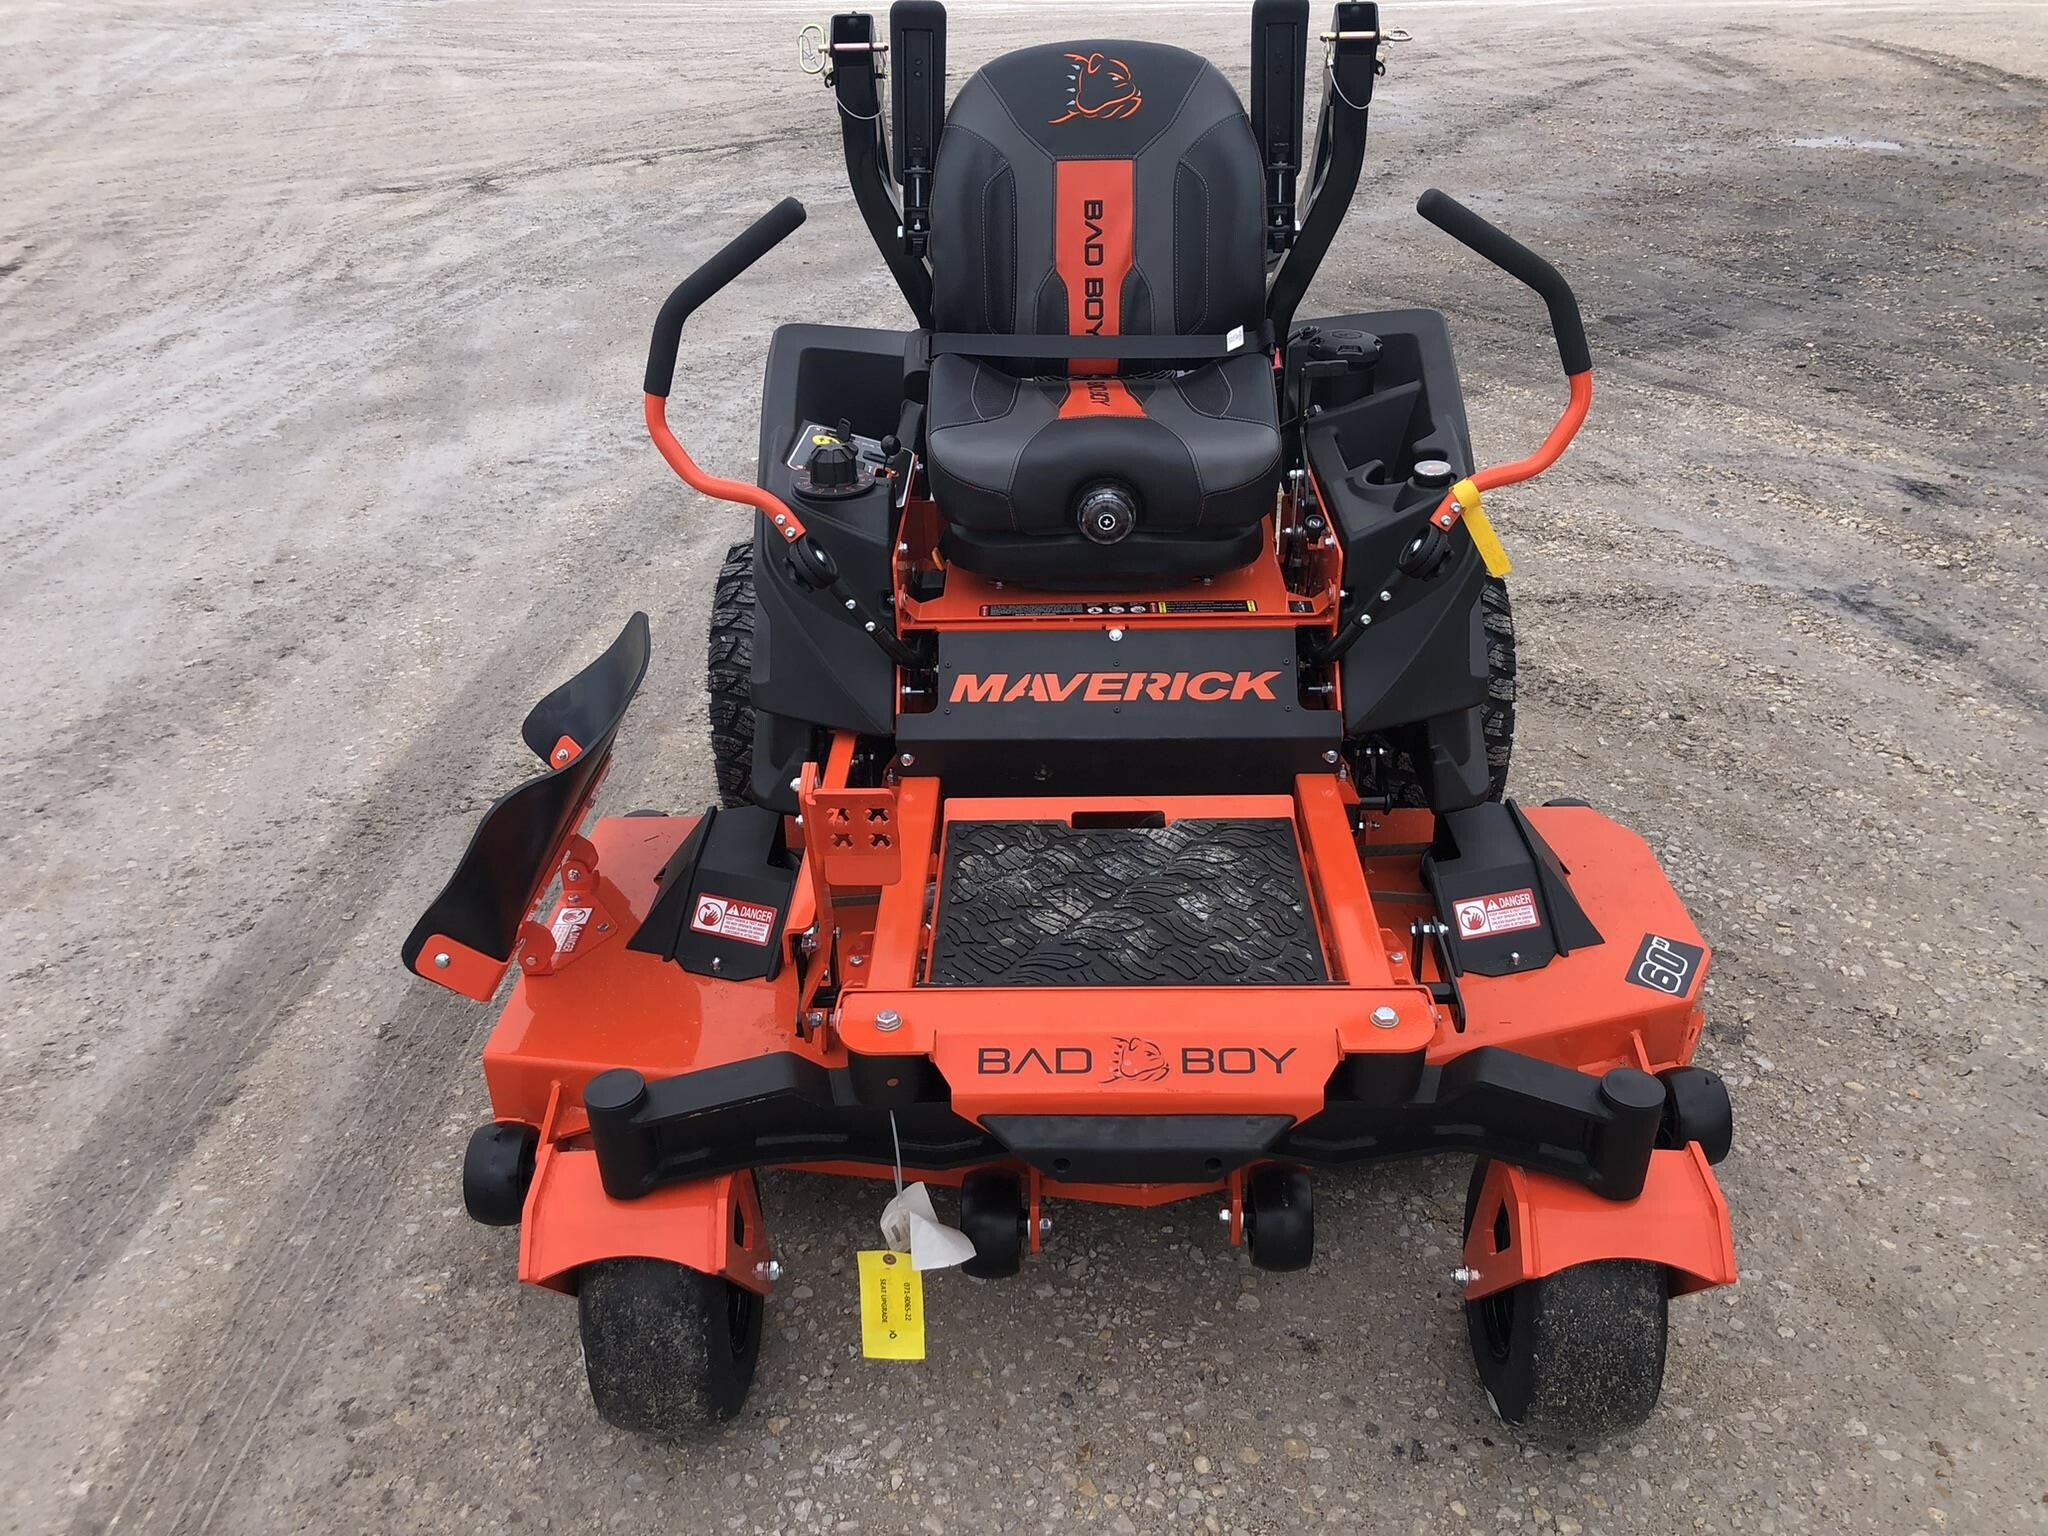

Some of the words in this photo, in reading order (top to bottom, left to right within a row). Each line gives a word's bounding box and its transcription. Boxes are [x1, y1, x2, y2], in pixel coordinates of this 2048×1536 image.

[1084, 200, 1104, 266] BAD
[1084, 278, 1104, 336] BOY
[949, 670, 1282, 703] MAVERICK
[740, 906, 773, 923] DANGER
[1498, 893, 1531, 908] DANGER
[978, 1048, 1092, 1074] BAD
[1182, 1048, 1297, 1074] BOY
